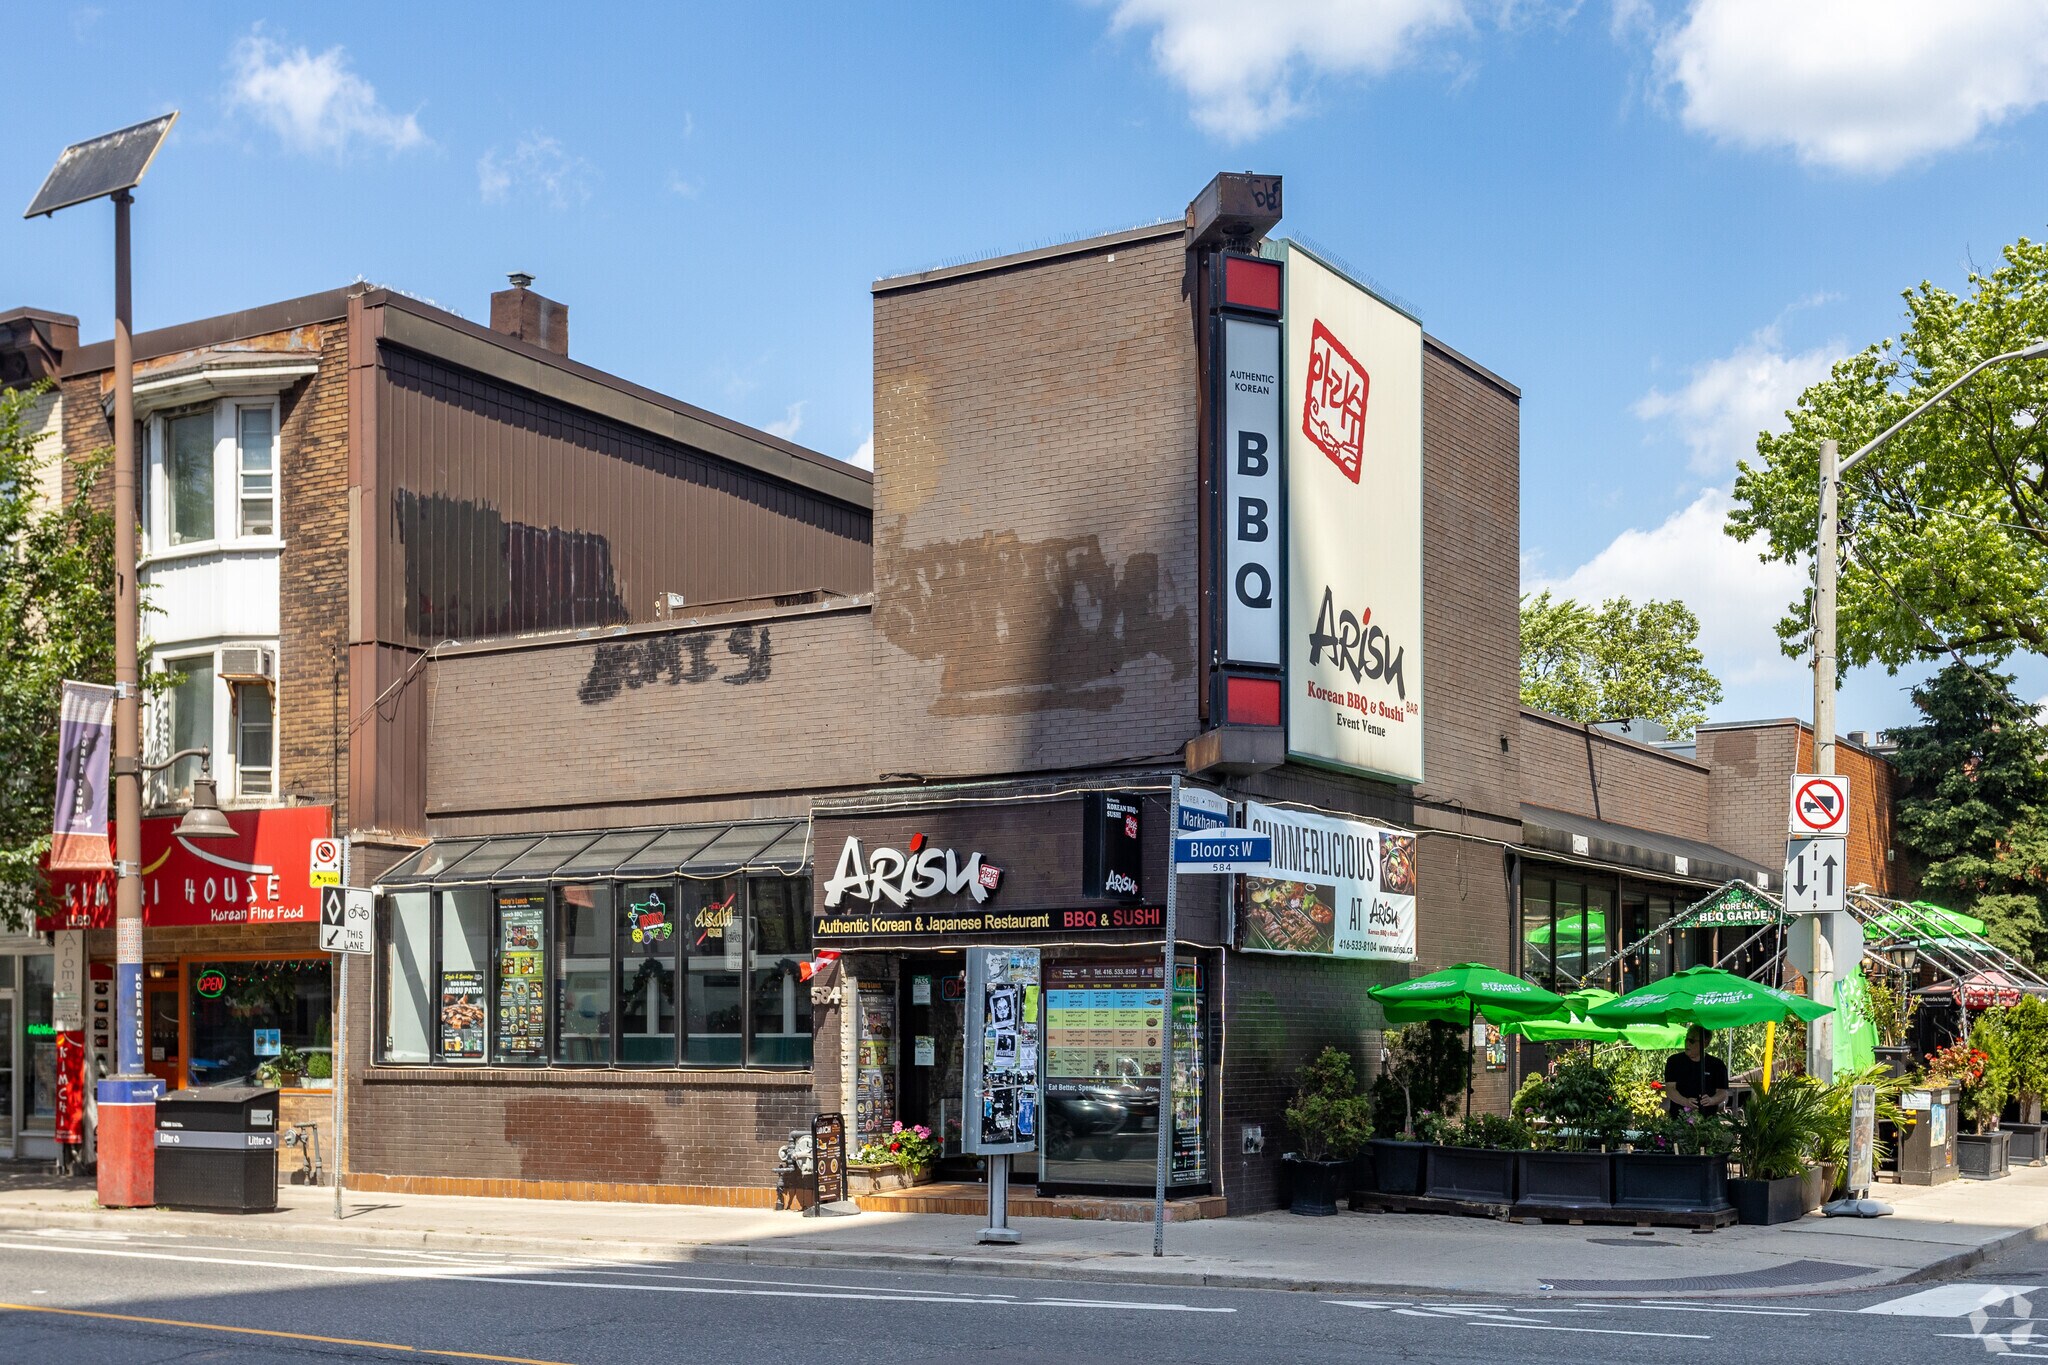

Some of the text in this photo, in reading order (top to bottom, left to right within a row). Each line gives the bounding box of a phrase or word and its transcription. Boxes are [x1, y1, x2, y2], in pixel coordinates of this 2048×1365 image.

[1229, 368, 1275, 384] AUTHENTIC
[1234, 382, 1270, 395] KOREAN
[1235, 430, 1272, 609] BBQ
[1307, 680, 1418, 723] Korean BBQ & Sushi BAR
[1336, 712, 1386, 738] Event Venue
[1106, 803, 1127, 811] KOREAN
[1183, 810, 1218, 830] Markham
[1190, 841, 1253, 858] Bloor St W
[1212, 863, 1232, 872] 584
[185, 875, 280, 904] HOUSE
[211, 907, 248, 921] Korean
[277, 905, 304, 919] Food
[1349, 897, 1362, 931] AT
[1719, 901, 1754, 911] KOREAN
[695, 906, 733, 928] Asahi
[818, 912, 1050, 934] Authentic Korean & Japanese Restaurant
[1063, 907, 1160, 928] BBQ & SUSHI
[1699, 909, 1776, 922] BBQ GARDEN
[346, 929, 363, 939] THIS
[344, 940, 364, 950] LANE
[1339, 939, 1413, 954] 416-533-8104 www.arisu.ca
[61, 931, 77, 992] Aroma
[200, 976, 223, 991] OPEN
[135, 973, 143, 1017] KOREA
[811, 986, 842, 1005] 584
[1702, 993, 1754, 1005] WHISTLE
[136, 1020, 144, 1055] TOWN
[58, 1046, 69, 1127] KIMCHI
[160, 1133, 174, 1144] Litter
[248, 1135, 265, 1146] Litter
